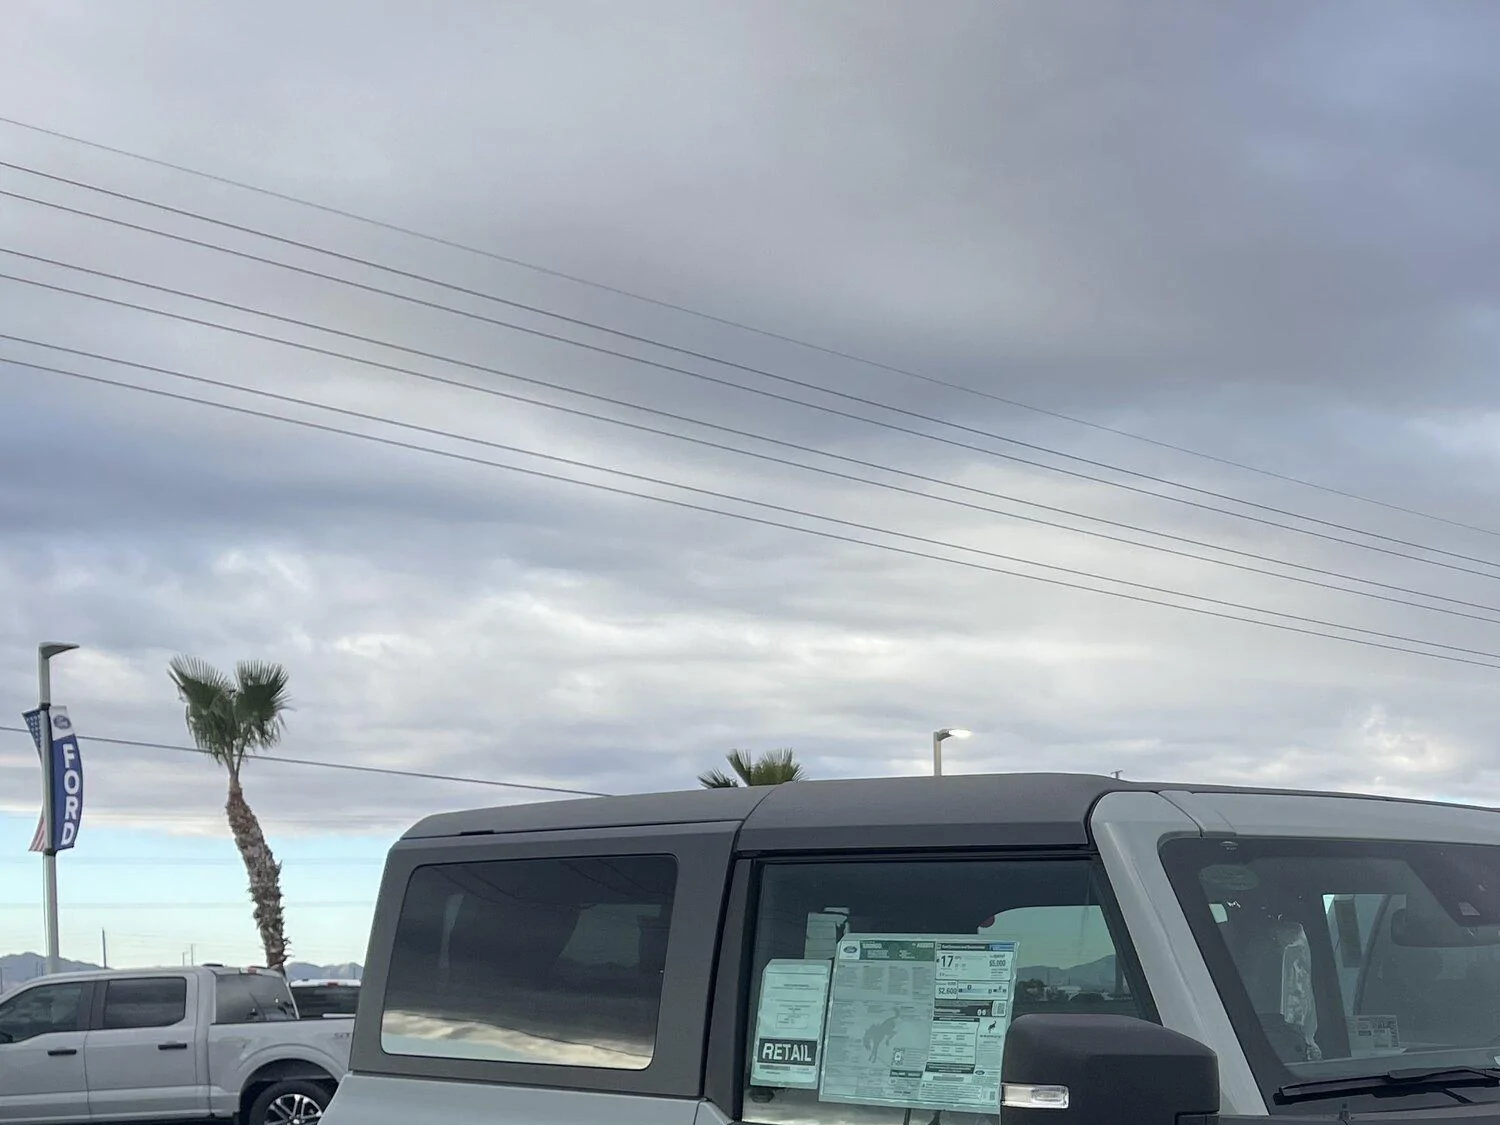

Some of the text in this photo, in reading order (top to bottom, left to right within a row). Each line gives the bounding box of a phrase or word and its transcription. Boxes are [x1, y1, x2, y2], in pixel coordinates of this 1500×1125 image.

[61, 743, 80, 845] FORD
[941, 955, 954, 968] 17
[762, 1042, 812, 1062] RETAIL
